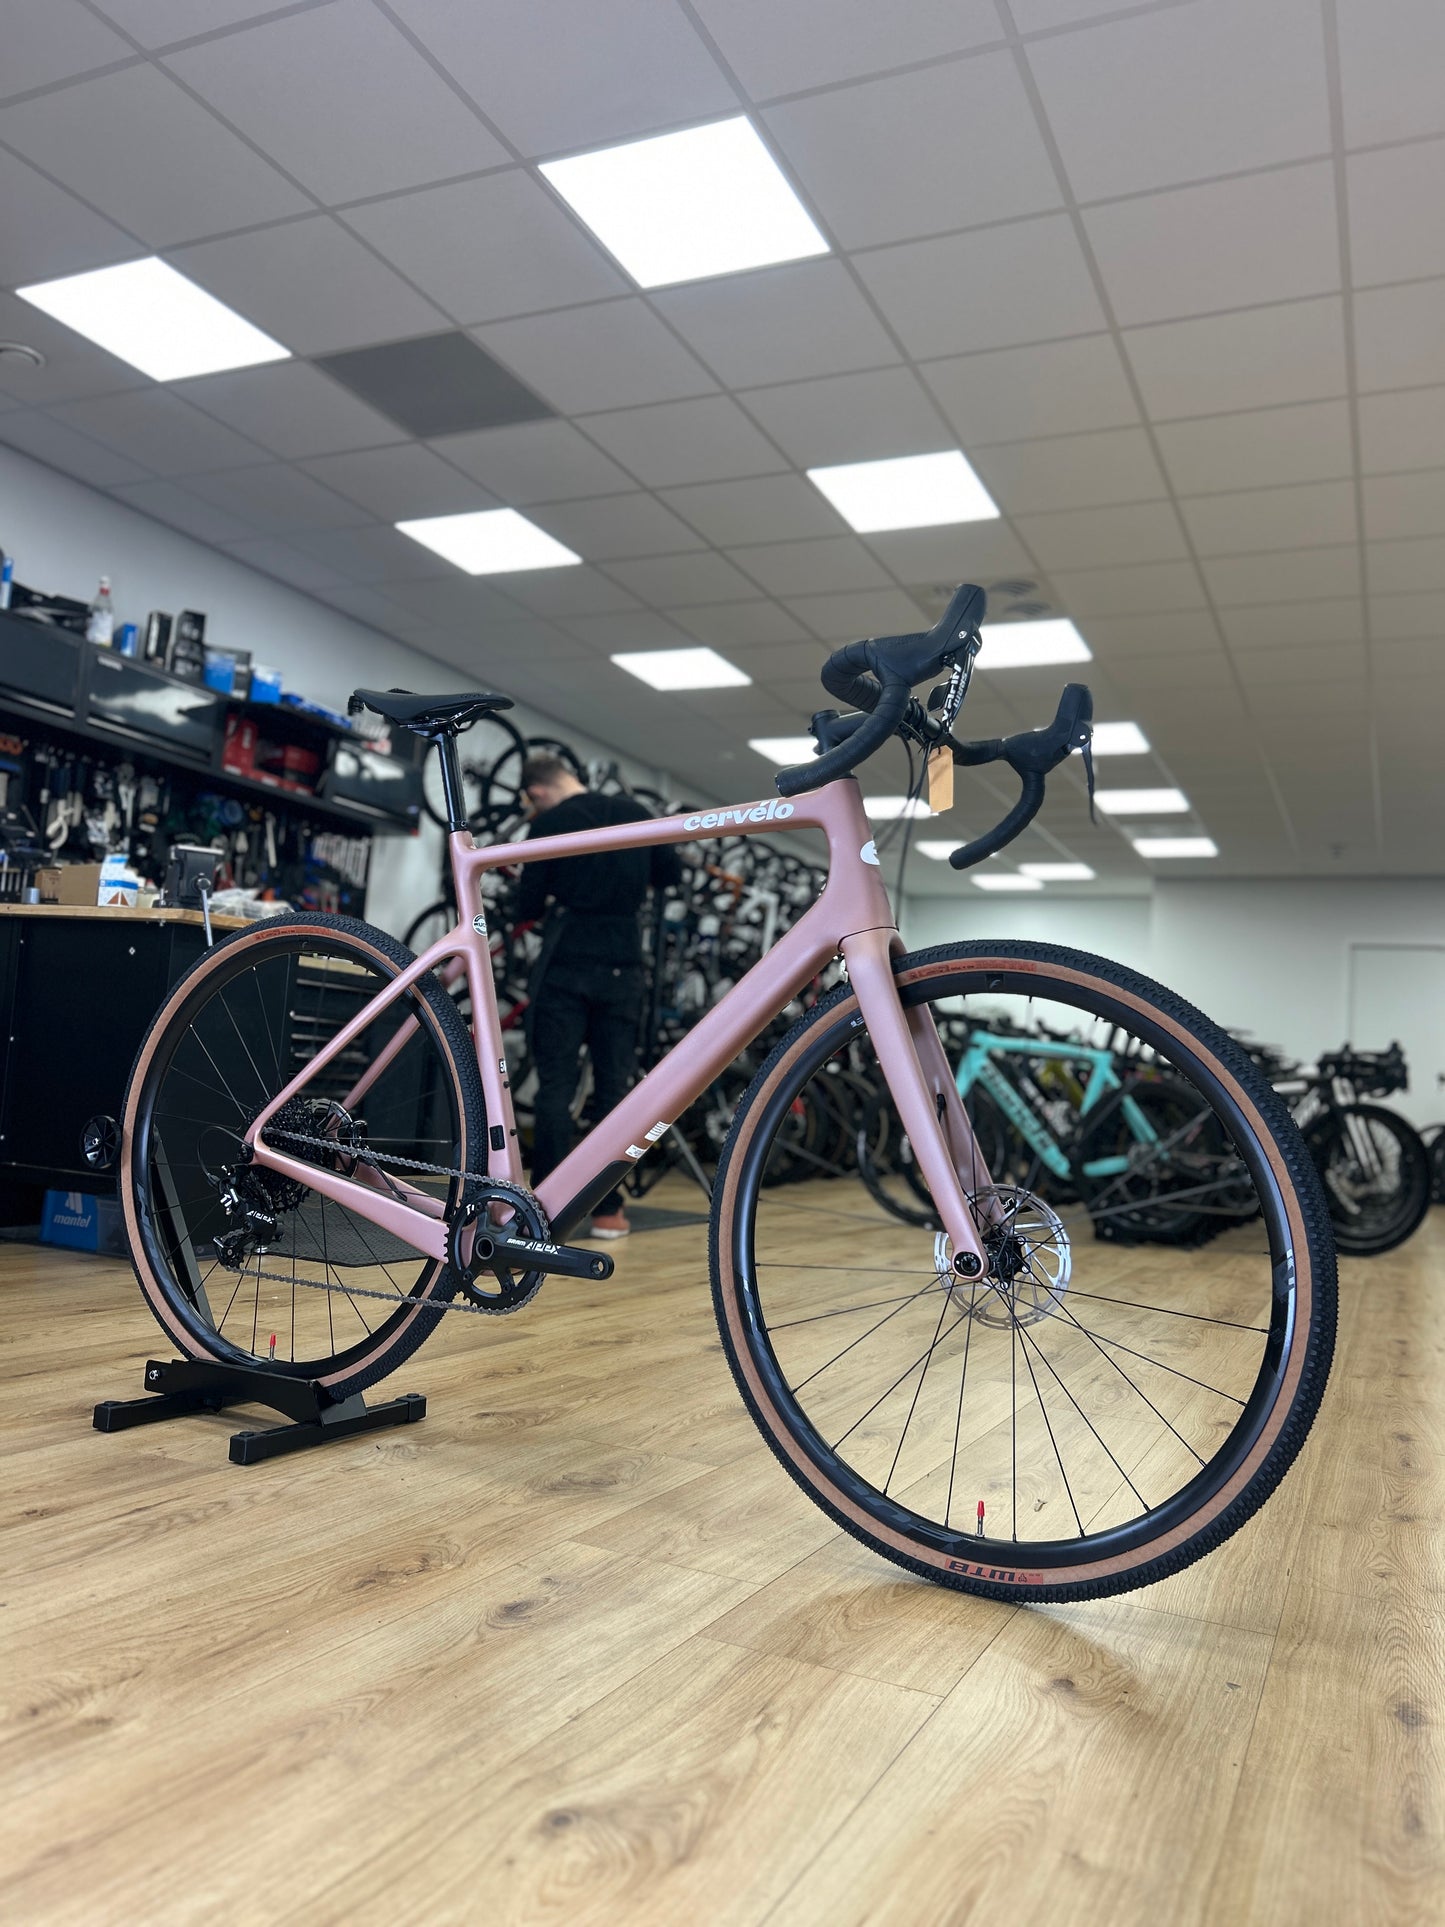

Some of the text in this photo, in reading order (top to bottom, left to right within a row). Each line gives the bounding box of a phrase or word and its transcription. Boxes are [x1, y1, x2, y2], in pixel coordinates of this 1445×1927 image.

[683, 799, 795, 831] cervélo
[53, 1214, 92, 1228] mantel
[506, 1238, 562, 1255] SRAM APEX
[949, 1560, 1015, 1582] WTB
